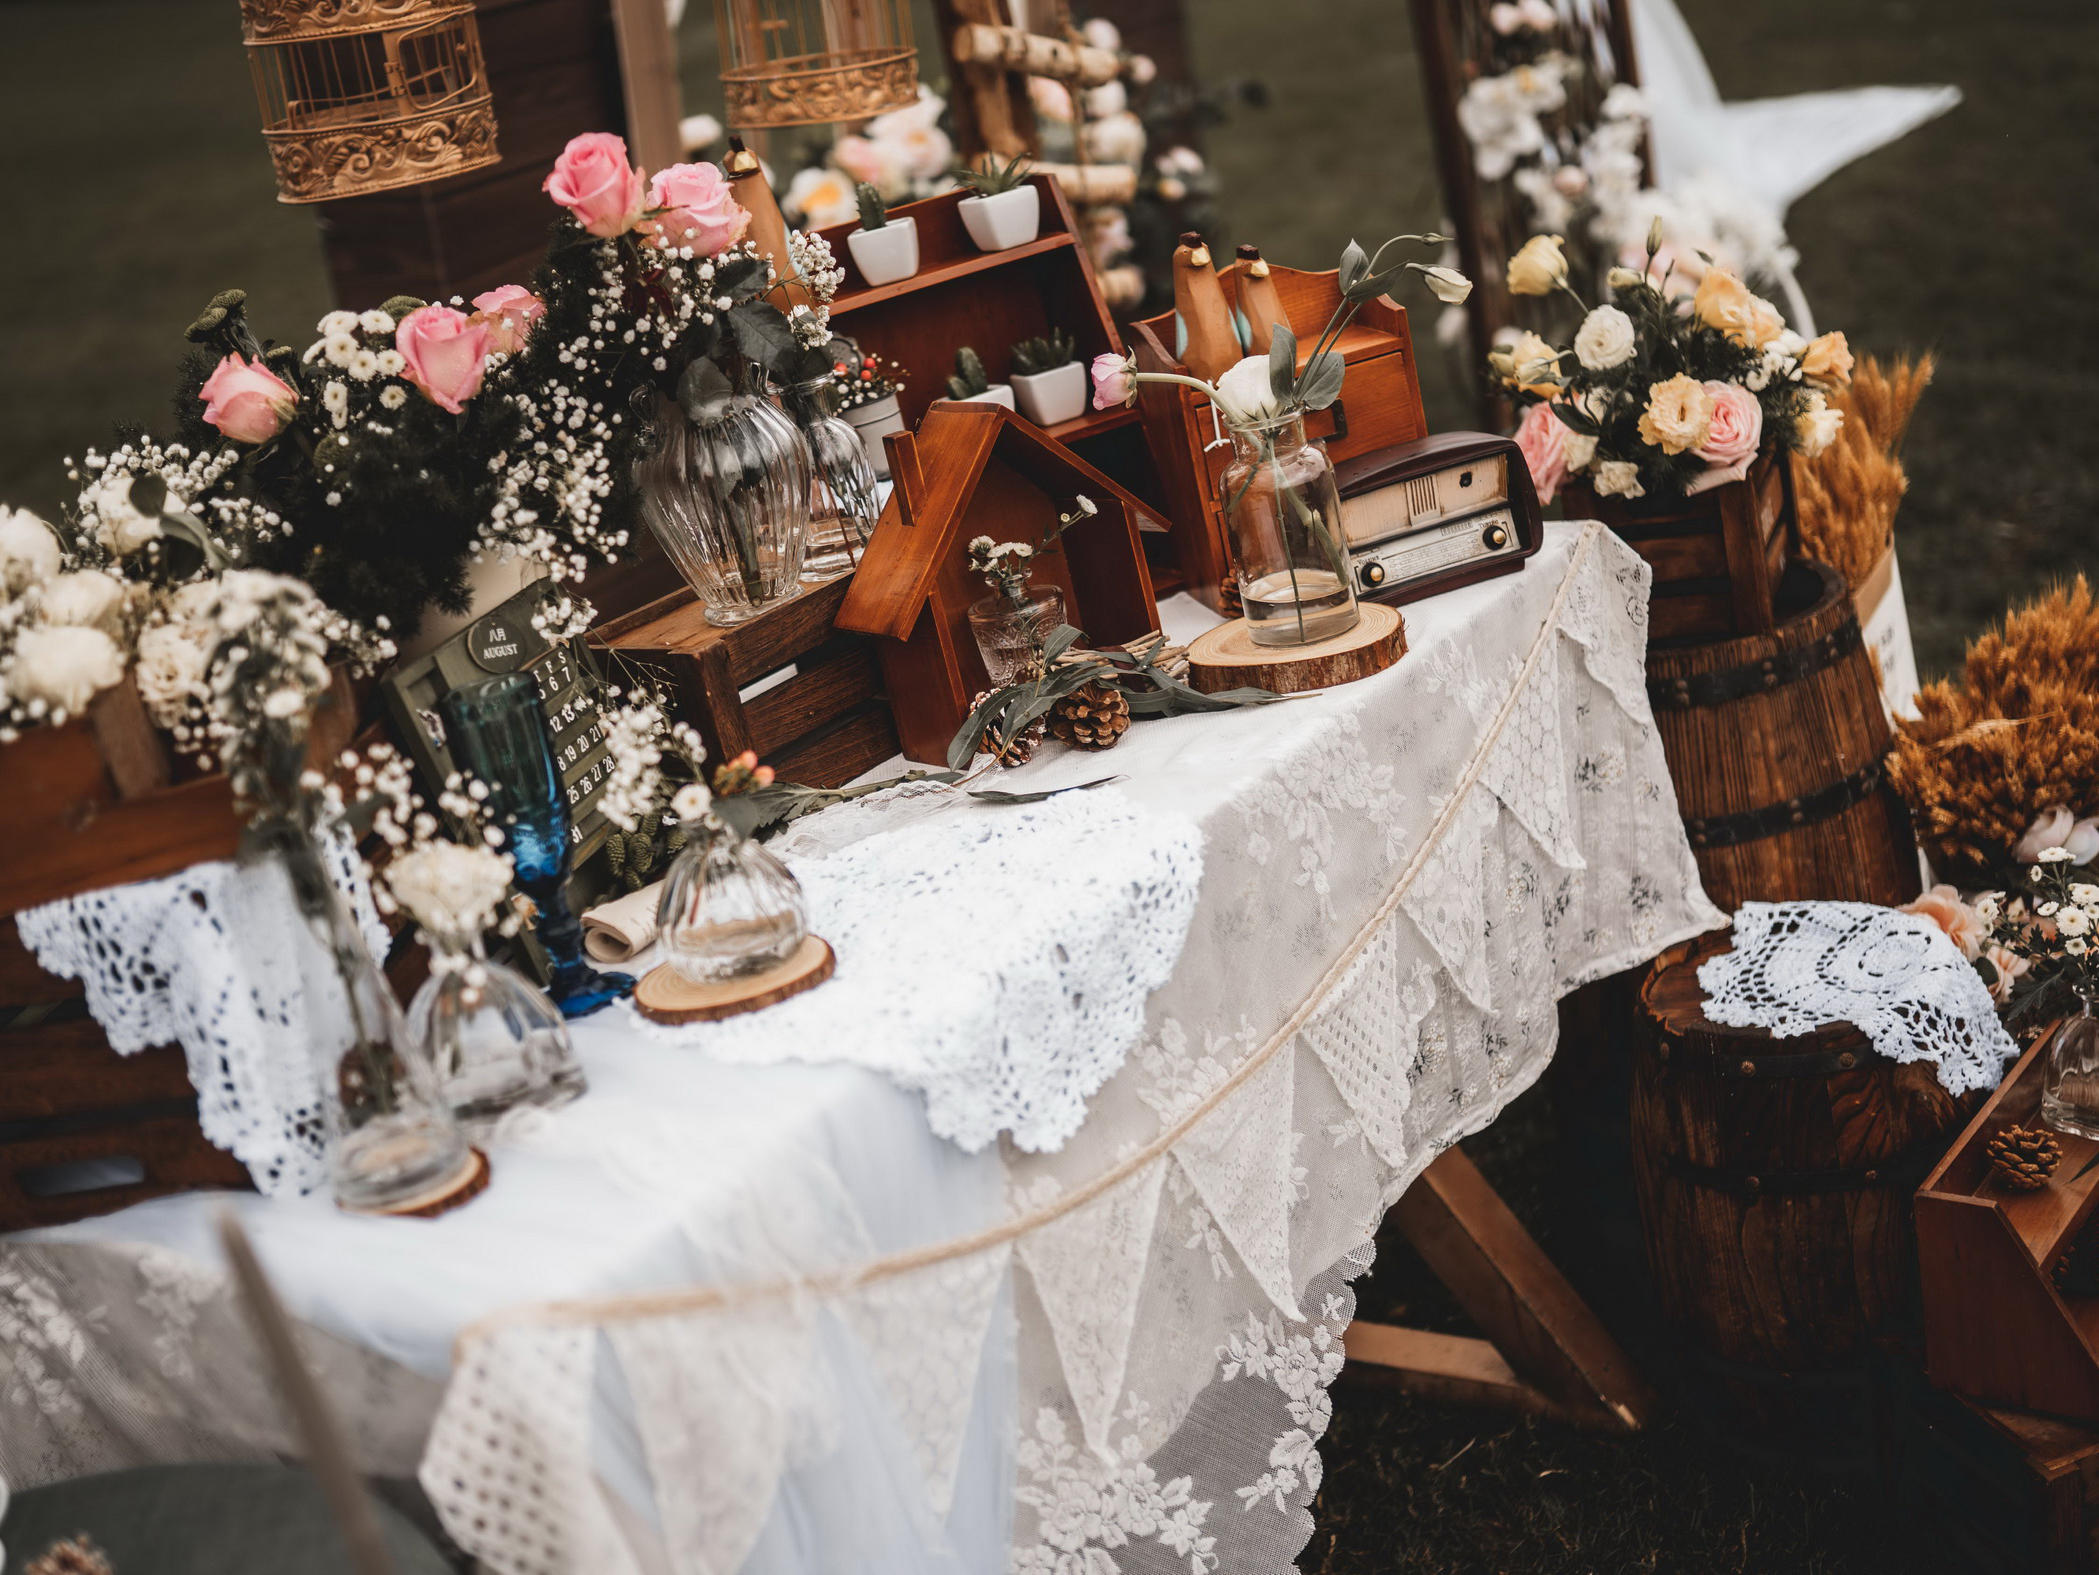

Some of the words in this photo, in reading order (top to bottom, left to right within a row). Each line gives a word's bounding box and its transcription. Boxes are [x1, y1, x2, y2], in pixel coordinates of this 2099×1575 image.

[489, 628, 507, 643] 八月
[483, 643, 518, 660] AUGUST
[545, 660, 553, 674] F
[558, 651, 567, 664] S
[548, 676, 559, 691] 6
[561, 666, 571, 682] 7
[550, 715, 564, 733] 12
[561, 704, 575, 723] 13
[564, 745, 577, 762] 19
[576, 734, 590, 753] 20
[590, 724, 601, 743] 21
[566, 785, 580, 804] 25
[579, 776, 593, 795] 26
[591, 763, 602, 782] 27
[602, 755, 615, 773] 28
[571, 825, 584, 844] 31
